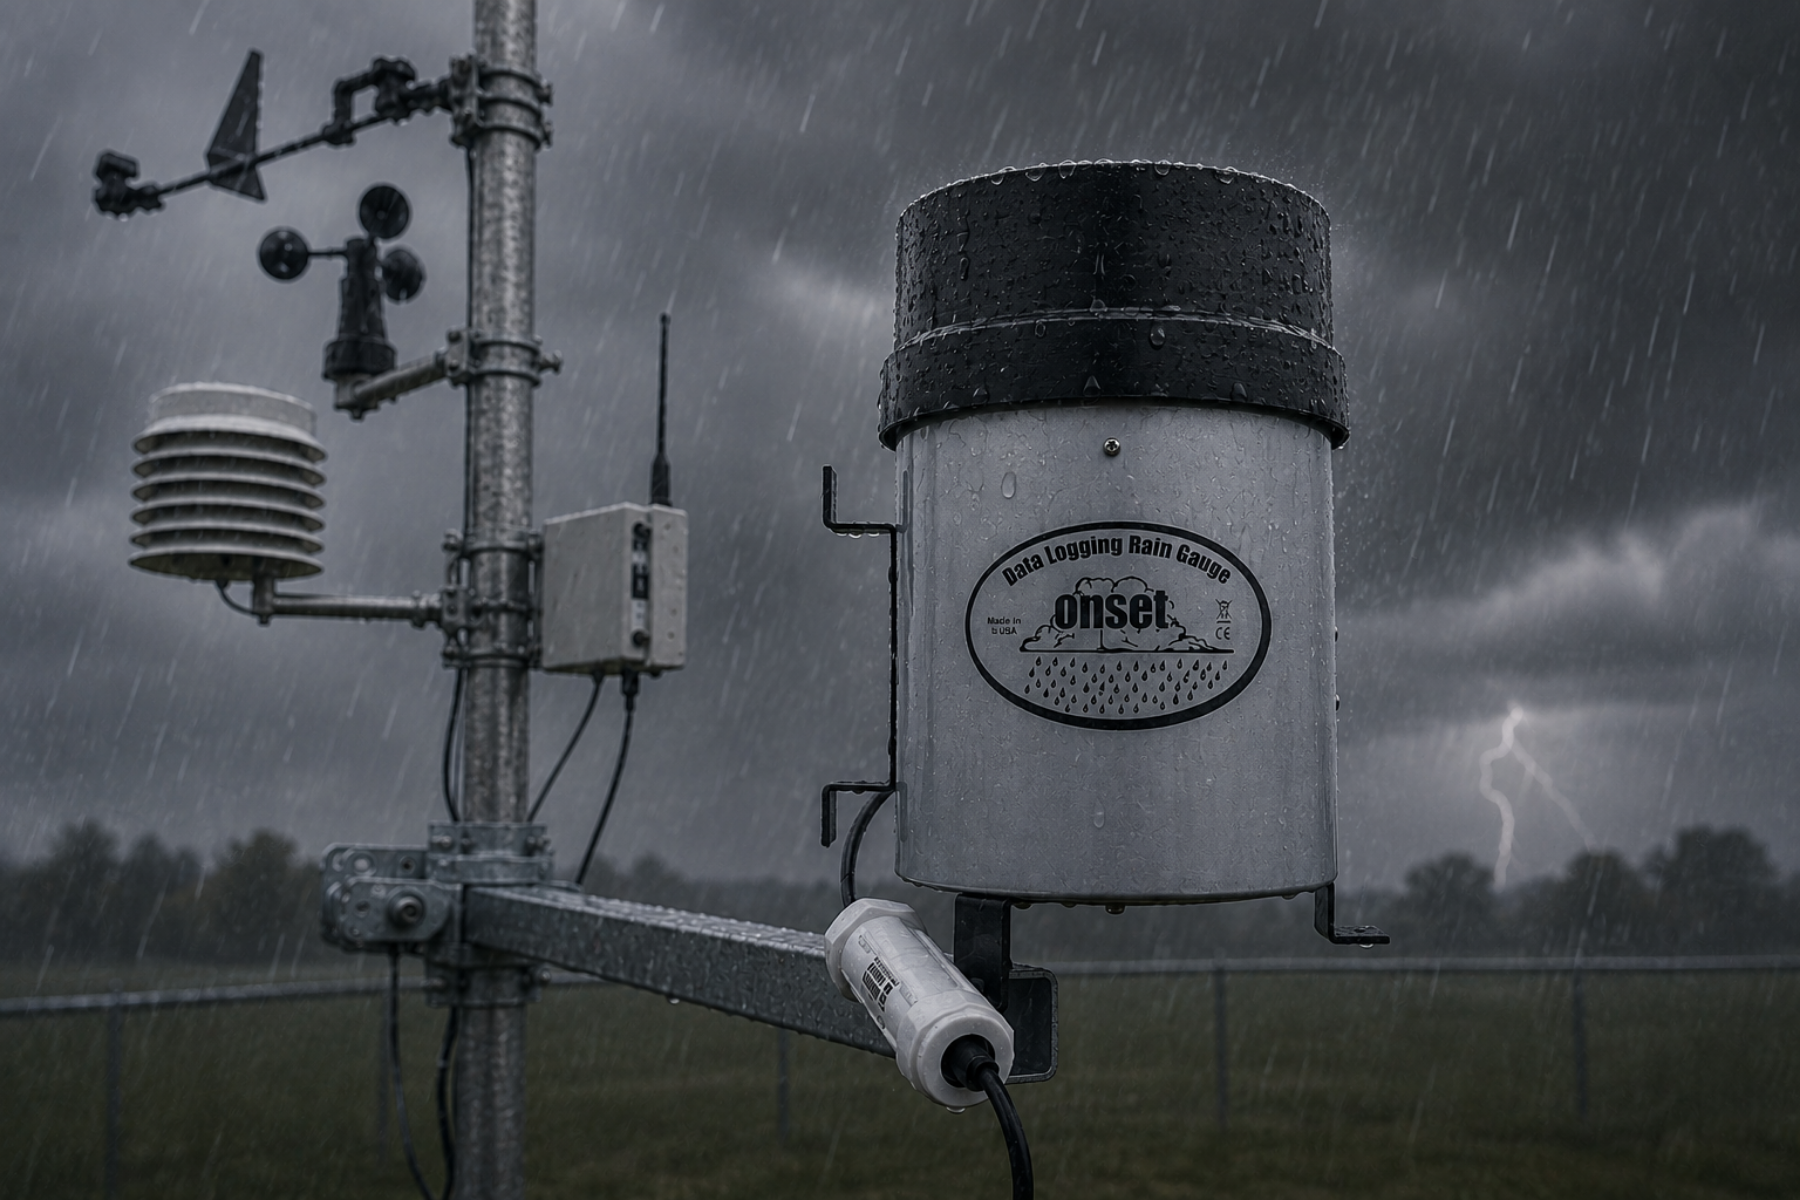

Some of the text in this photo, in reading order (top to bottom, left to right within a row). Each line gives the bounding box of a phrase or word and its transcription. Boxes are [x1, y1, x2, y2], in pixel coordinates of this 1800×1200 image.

[1002, 535, 1231, 586] Data Logging Rain Gauge
[987, 616, 1011, 625] Made
[1055, 590, 1169, 629] onset
